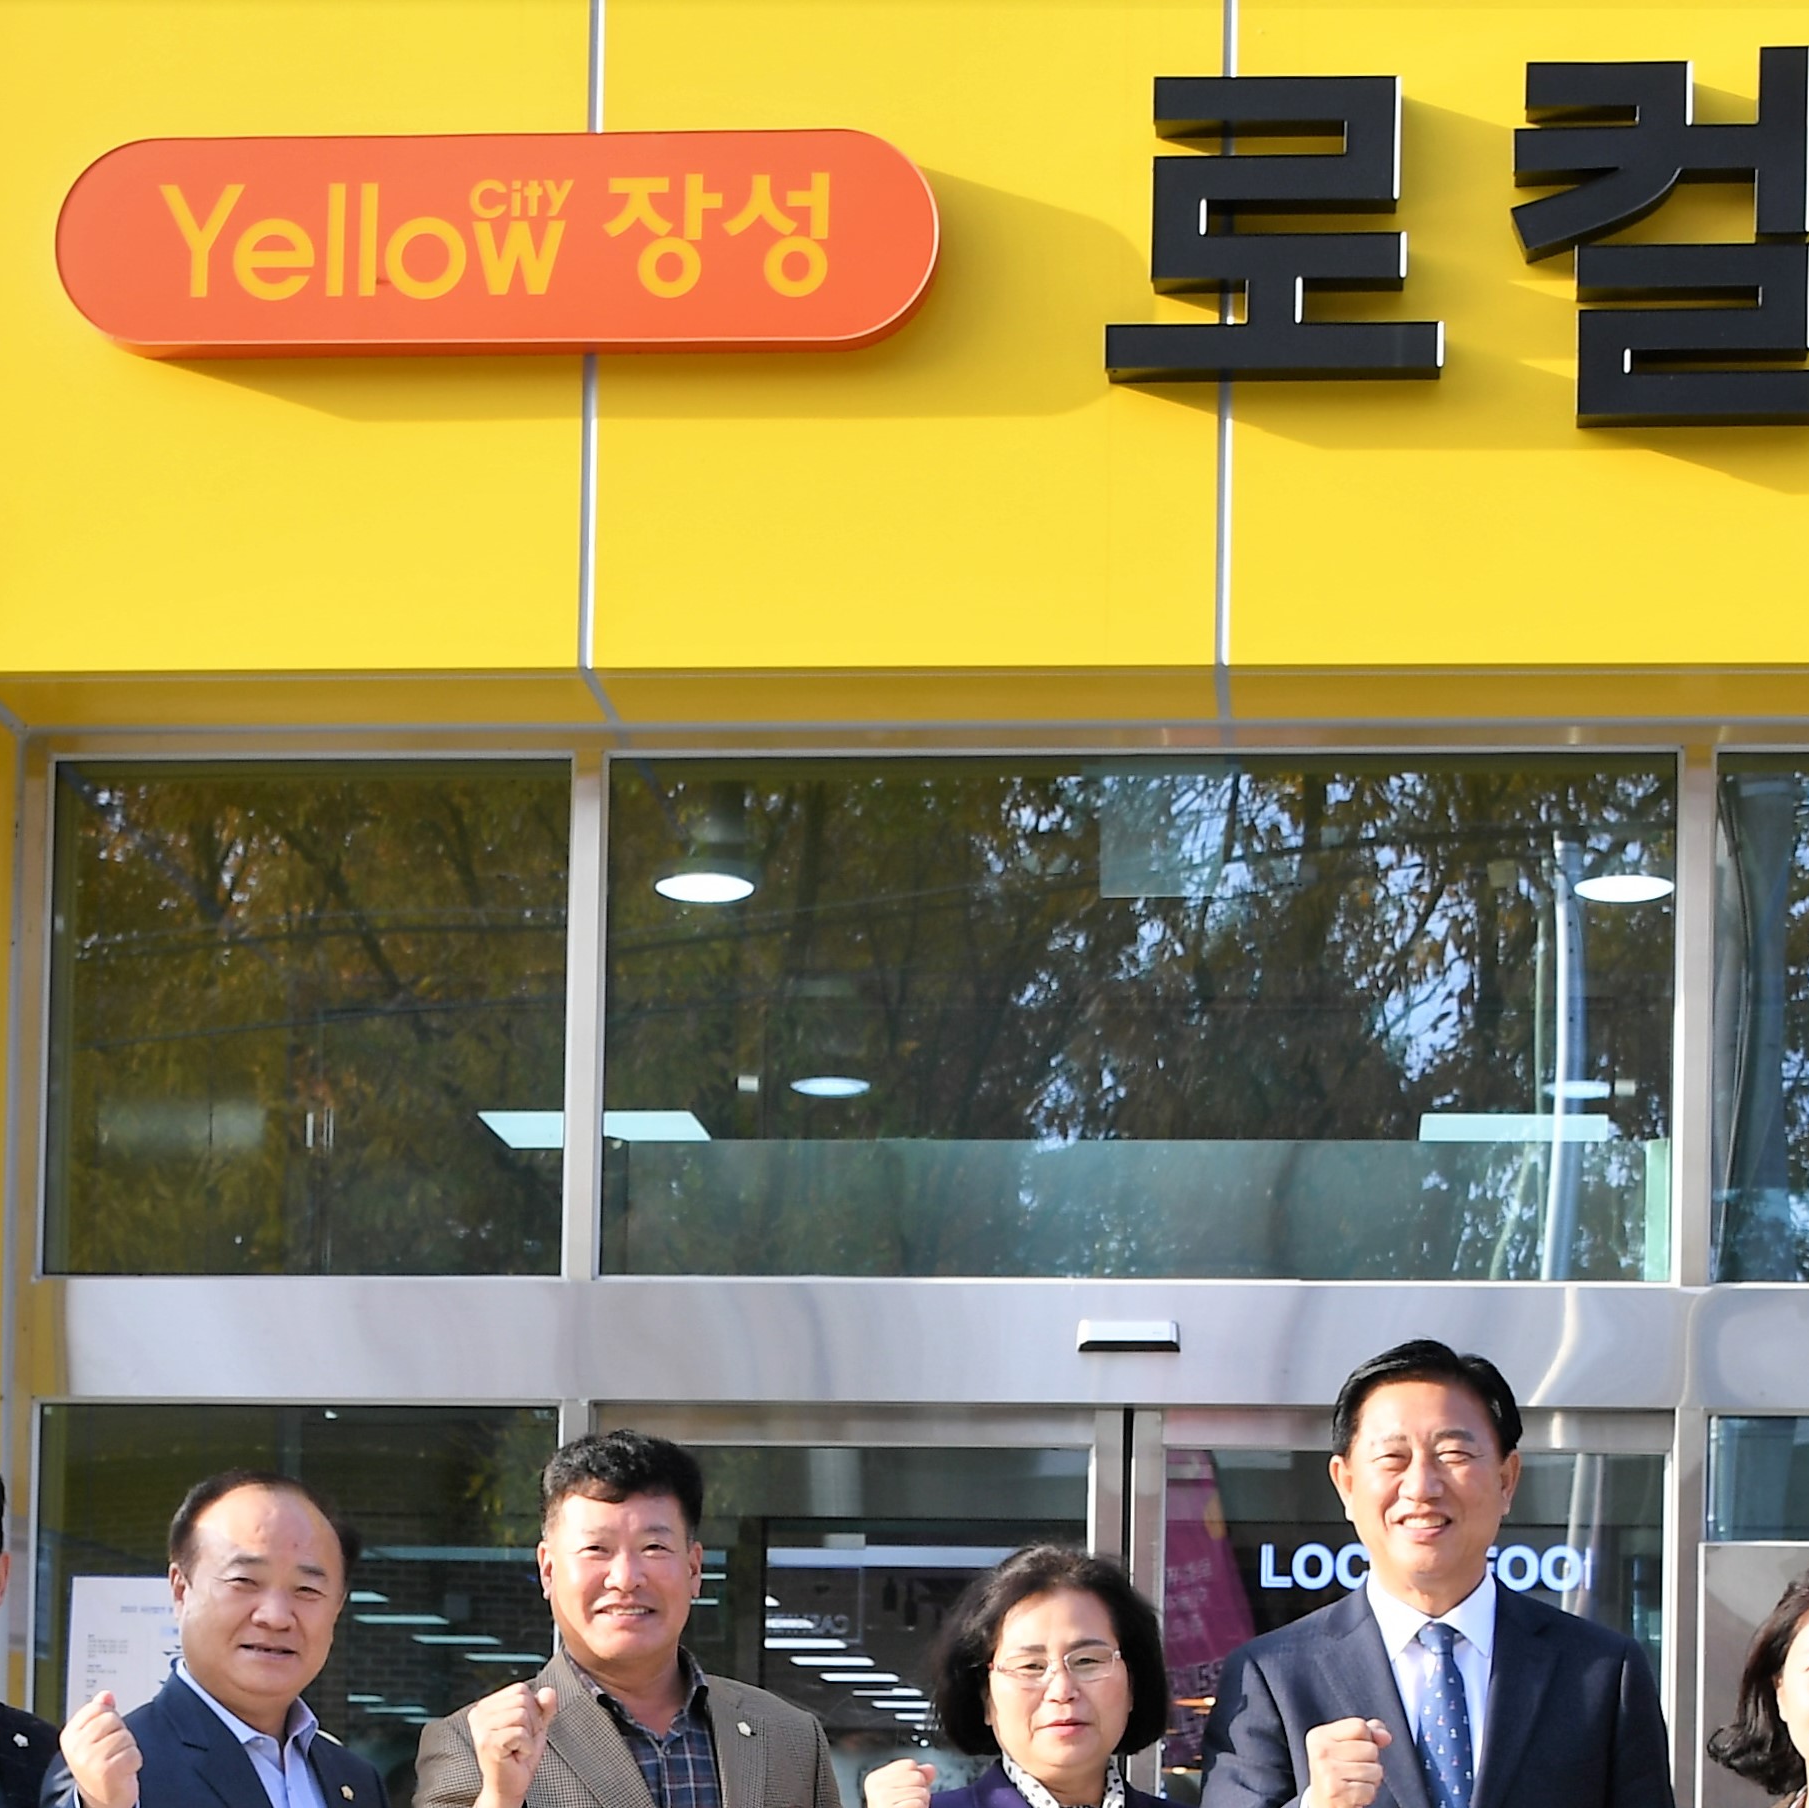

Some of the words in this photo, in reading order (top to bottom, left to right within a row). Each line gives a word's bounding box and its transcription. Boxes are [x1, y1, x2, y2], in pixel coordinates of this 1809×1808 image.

[158, 182, 567, 301] Yellow
[469, 178, 575, 219] City
[601, 171, 831, 300] 장성
[1259, 1542, 1370, 1591] LOC
[1485, 1544, 1592, 1592] OO
